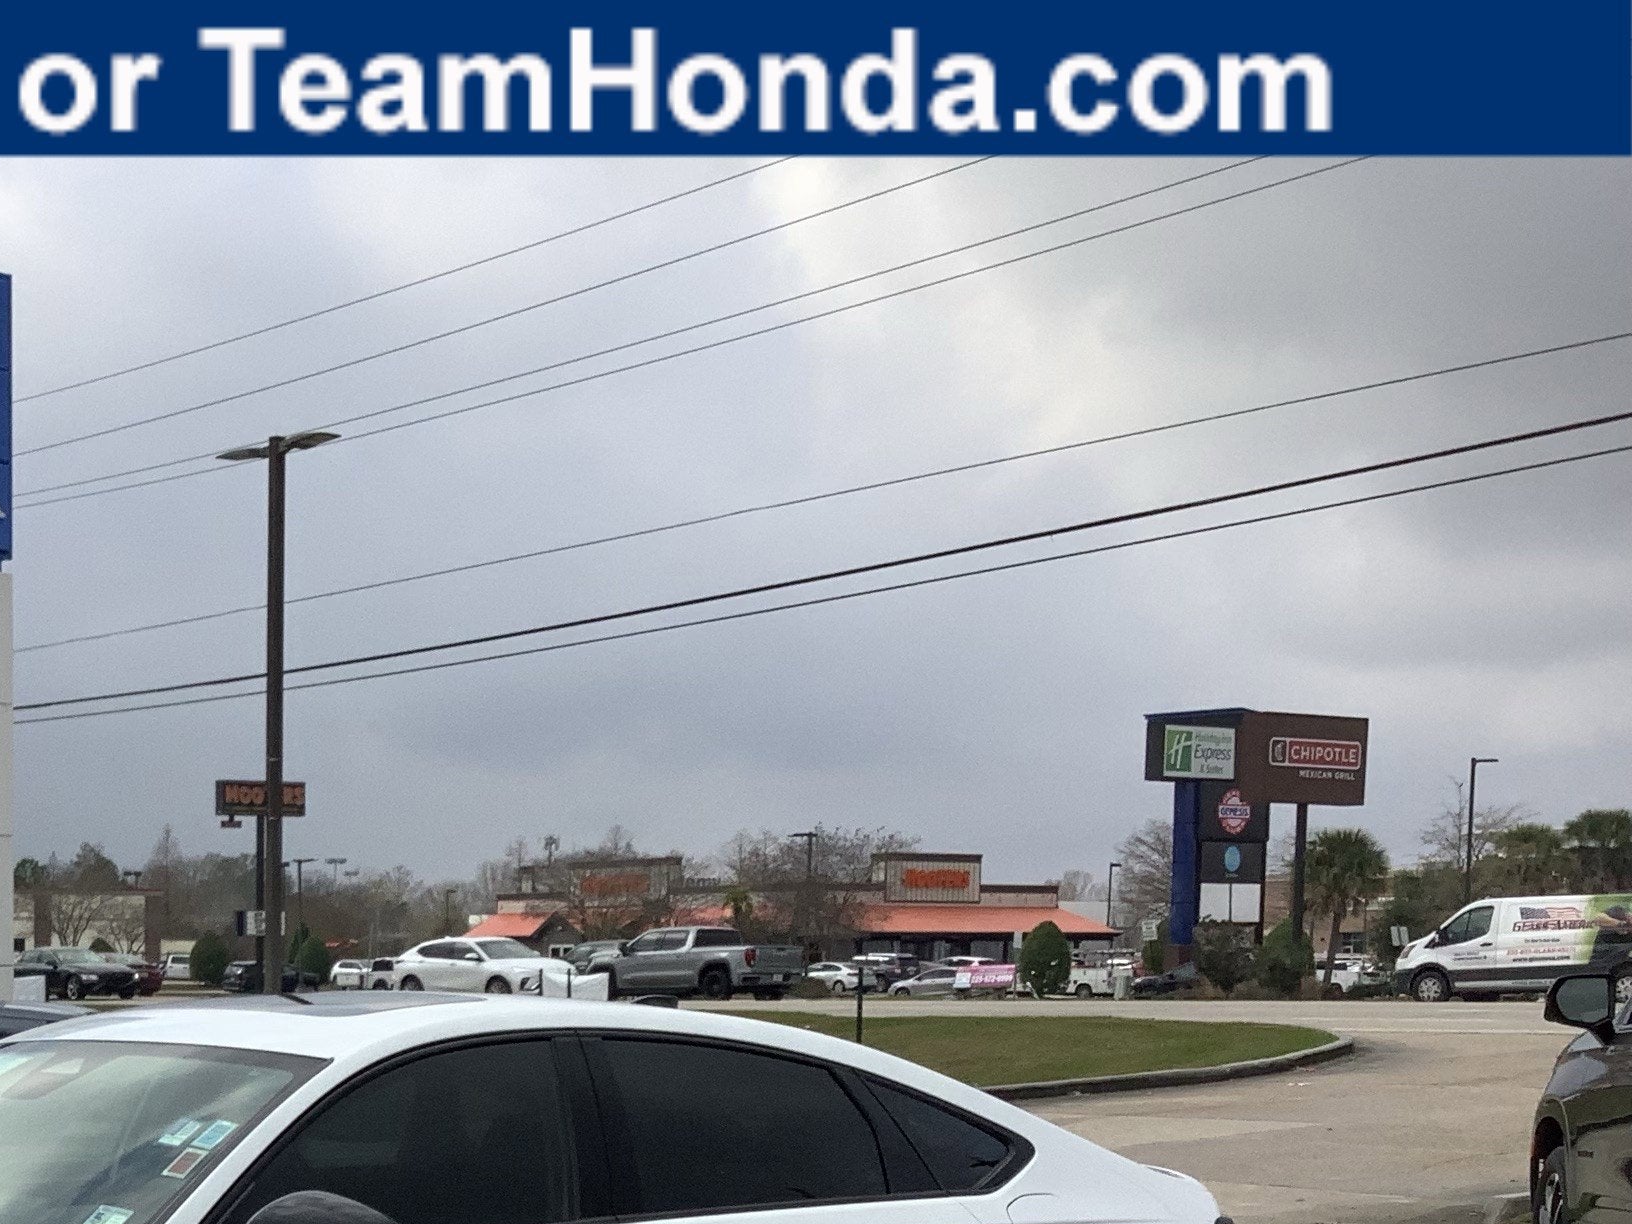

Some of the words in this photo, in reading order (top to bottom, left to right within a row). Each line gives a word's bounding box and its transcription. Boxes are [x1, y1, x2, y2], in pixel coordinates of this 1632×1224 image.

[1193, 744, 1232, 763] Express
[1290, 745, 1358, 763] CHIPOTLE
[1299, 770, 1333, 779] MEXICAN
[1334, 771, 1356, 781] GRILL
